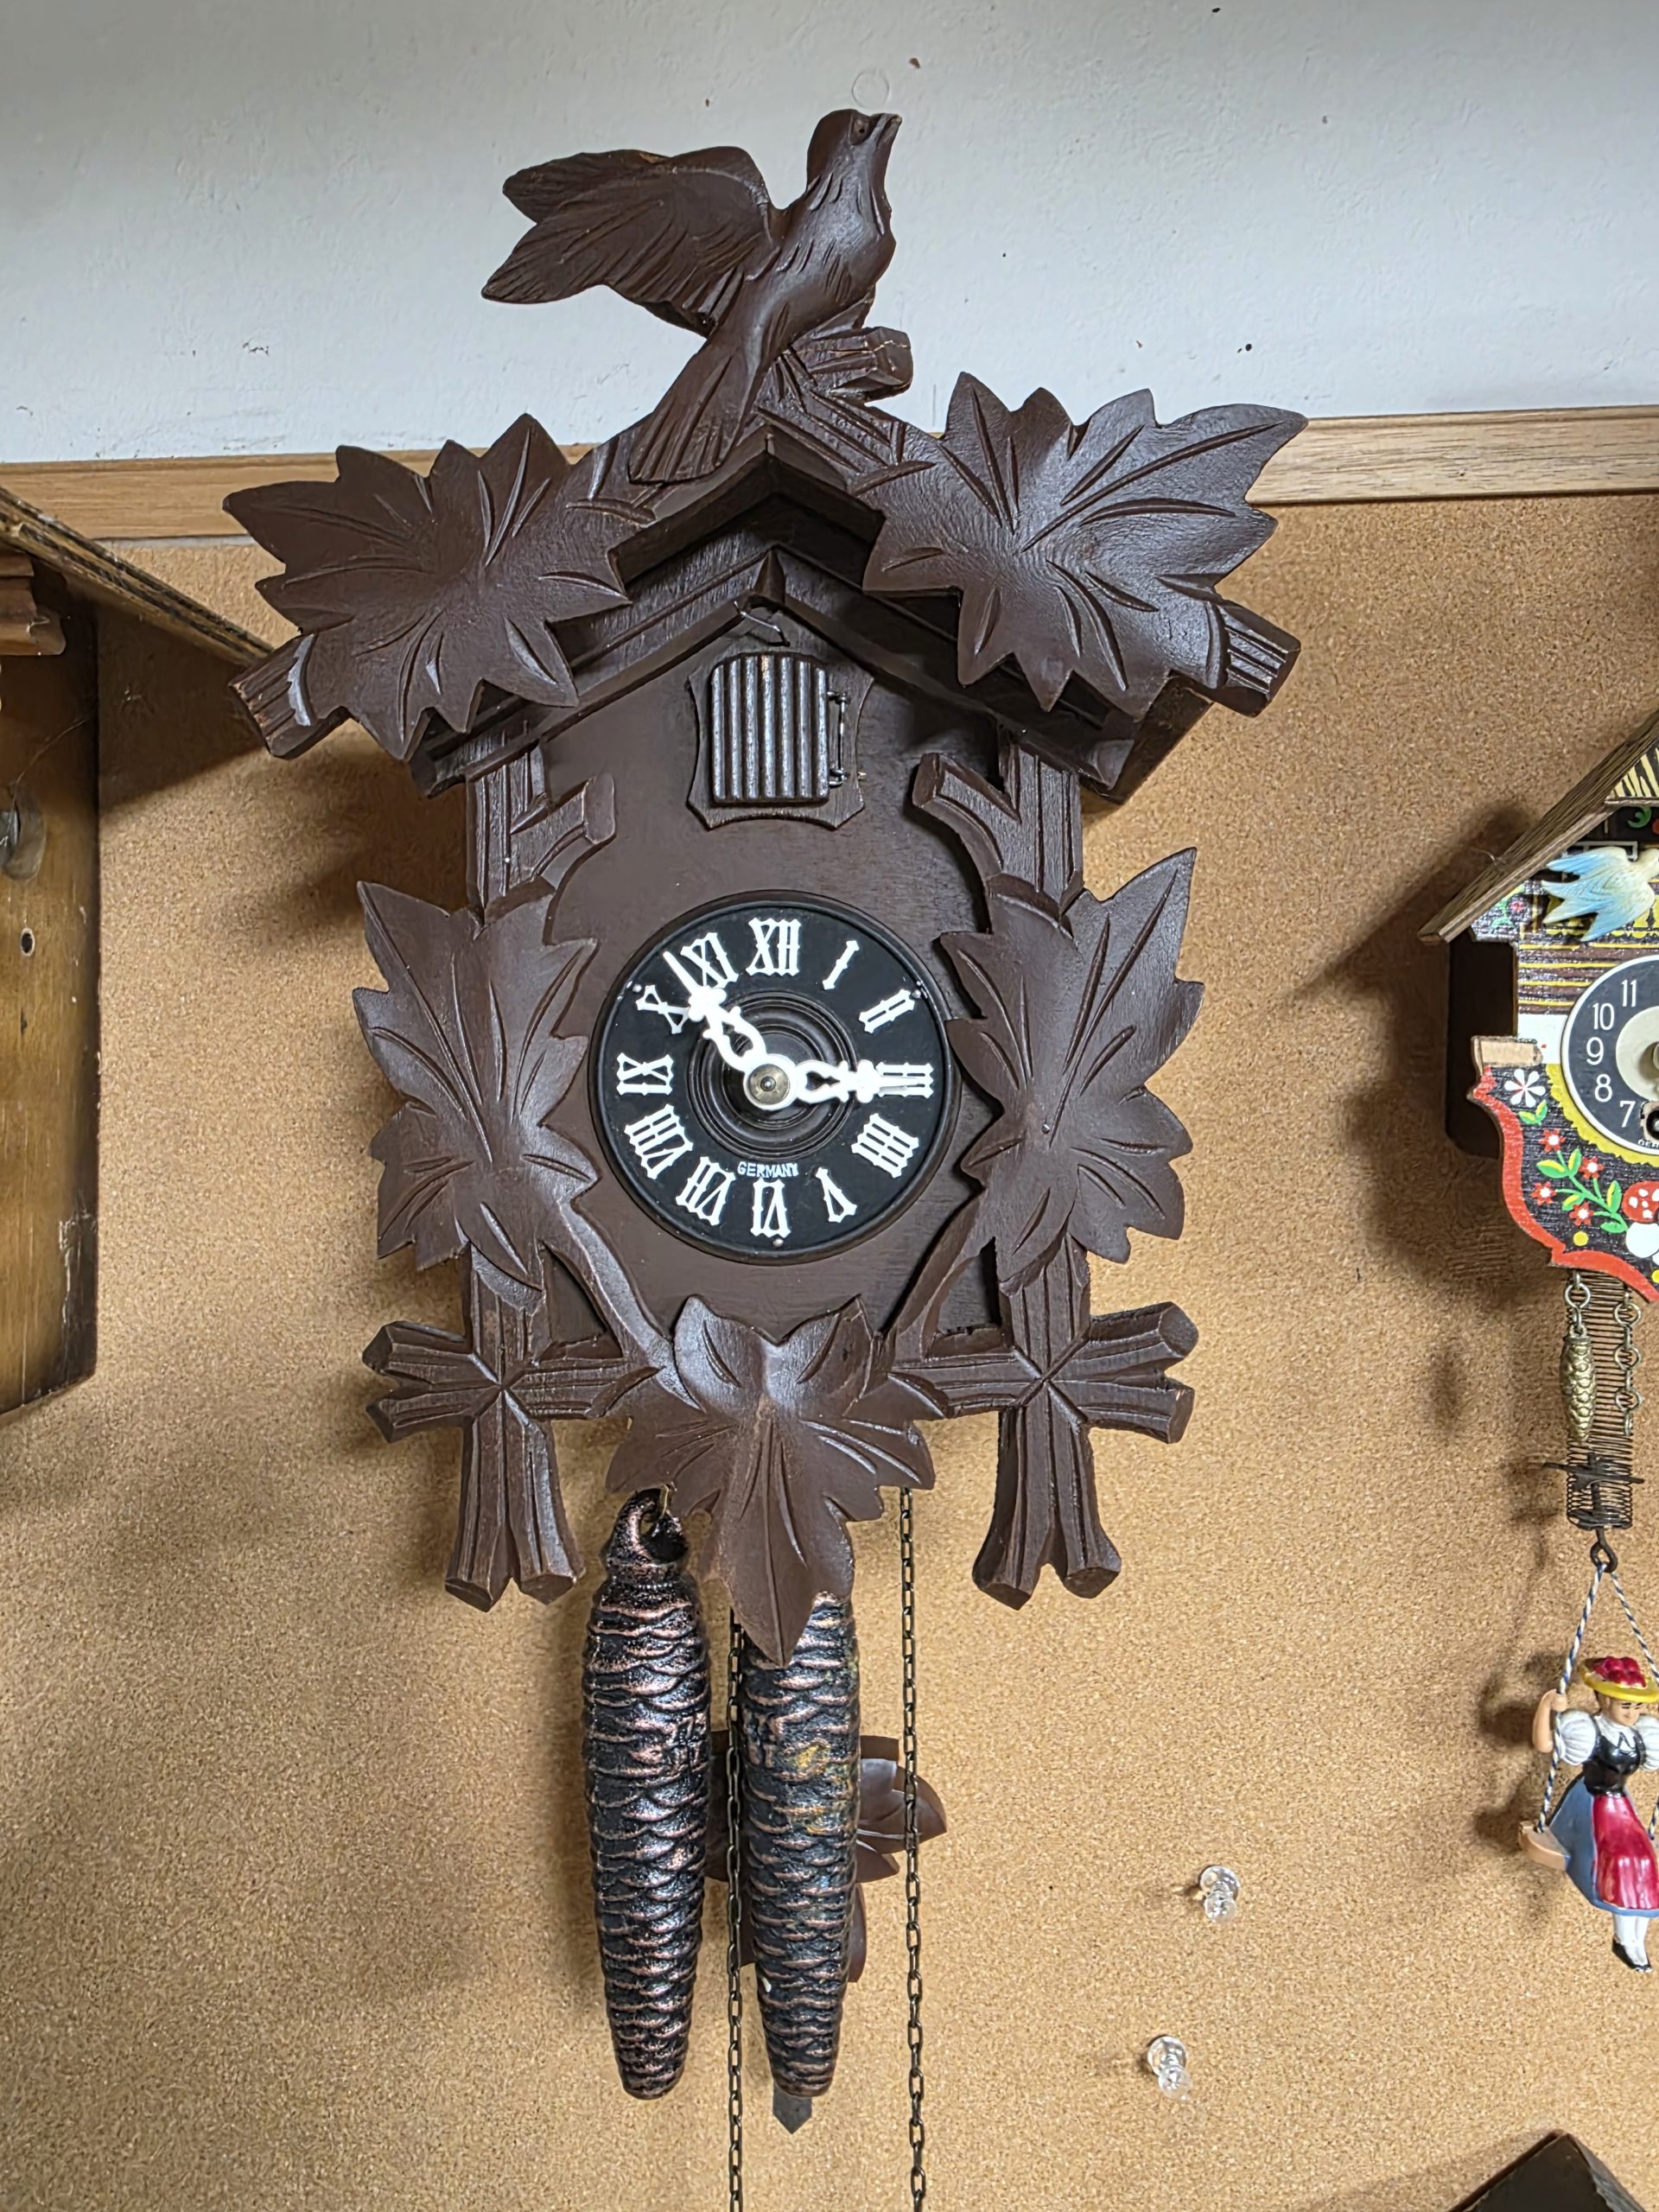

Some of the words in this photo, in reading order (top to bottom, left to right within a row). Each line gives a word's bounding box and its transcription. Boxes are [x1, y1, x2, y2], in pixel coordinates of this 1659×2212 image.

[681, 932, 740, 989] XI
[746, 917, 802, 976] XII
[822, 940, 860, 990] I
[636, 984, 691, 1034] X
[859, 988, 916, 1034] II
[1592, 1002, 1615, 1031] 10
[1621, 979, 1637, 1007] 11
[616, 1052, 674, 1096] IX
[1586, 1037, 1605, 1065] 9
[1594, 1073, 1613, 1103] 8
[1619, 1100, 1637, 1128] 7
[624, 1103, 694, 1179] VIII
[851, 1112, 920, 1178] IIII
[676, 1156, 737, 1226] VII
[737, 1161, 799, 1178] GERMANY
[815, 1166, 858, 1223] V
[751, 1179, 791, 1237] VI
